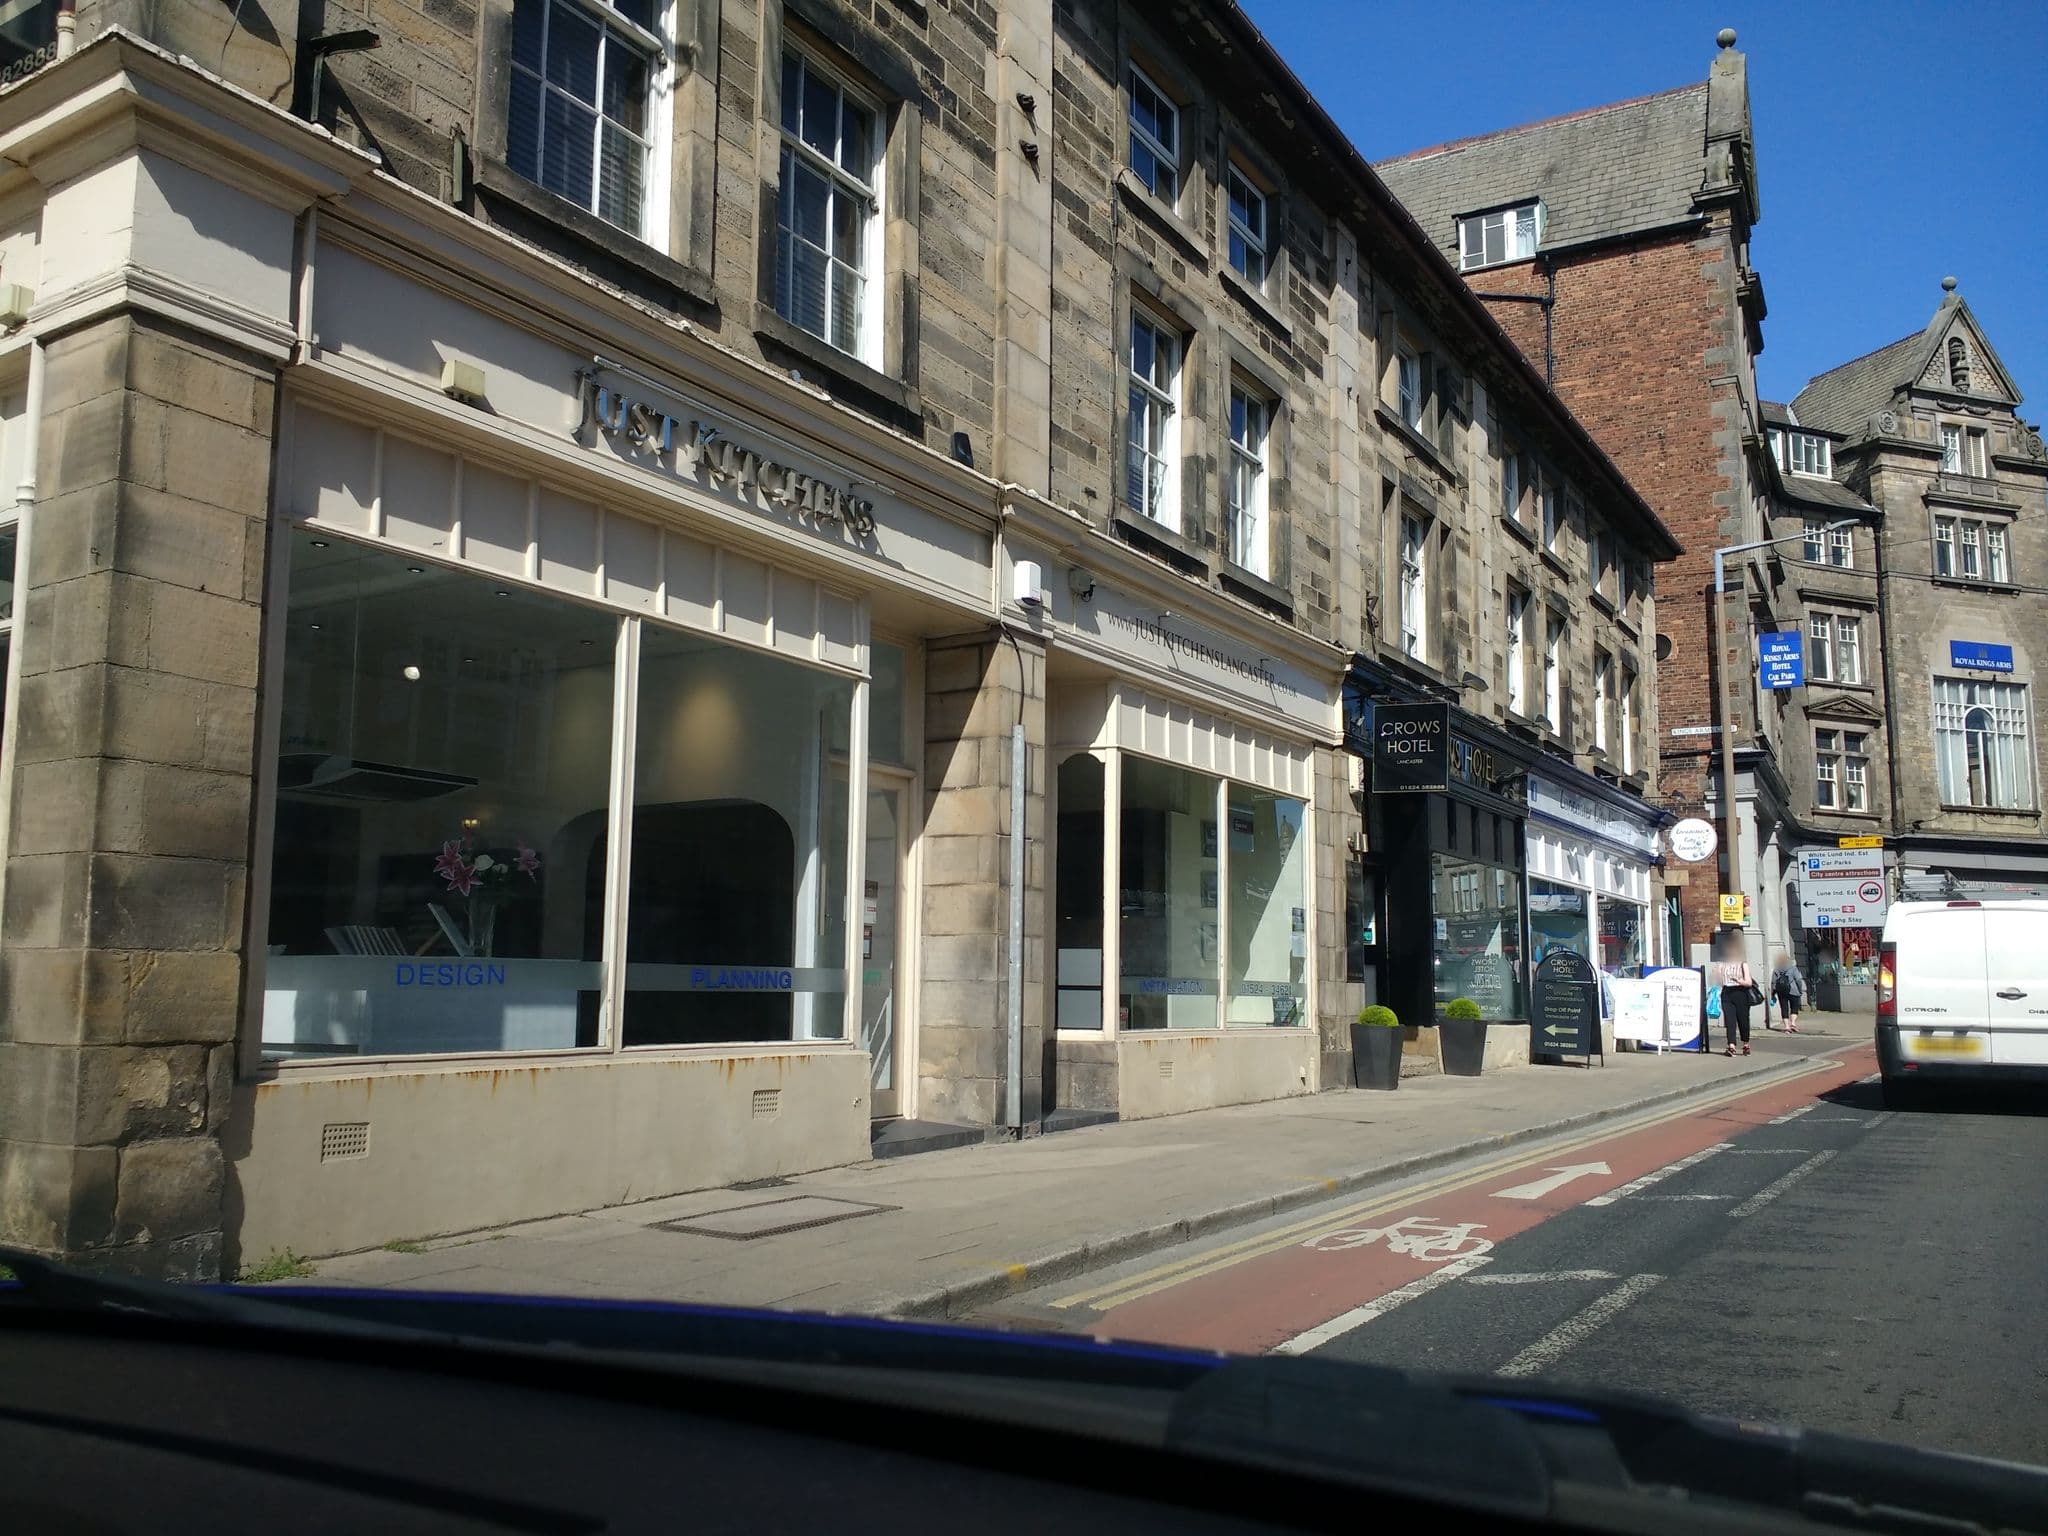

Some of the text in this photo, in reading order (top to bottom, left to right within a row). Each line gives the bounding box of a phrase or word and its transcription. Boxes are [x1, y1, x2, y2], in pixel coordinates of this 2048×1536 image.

[572, 368, 875, 538] JUST KITCHENS
[1771, 644, 1791, 653] ROYAL
[1763, 652, 1800, 662] KINGS ARMS
[1955, 657, 2012, 669] ROYAL KINGS ARMS
[1771, 662, 1792, 670] HOTEL
[1767, 672, 1796, 681] CAR PARK
[1381, 720, 1440, 735] CROWS
[1387, 739, 1435, 753] HOTEL
[1464, 743, 1497, 784] HOTEL
[1550, 959, 1580, 967] CROWS
[395, 963, 506, 987] DESIGN
[1552, 966, 1576, 974] HOTEL
[690, 967, 793, 990] PLANNING
